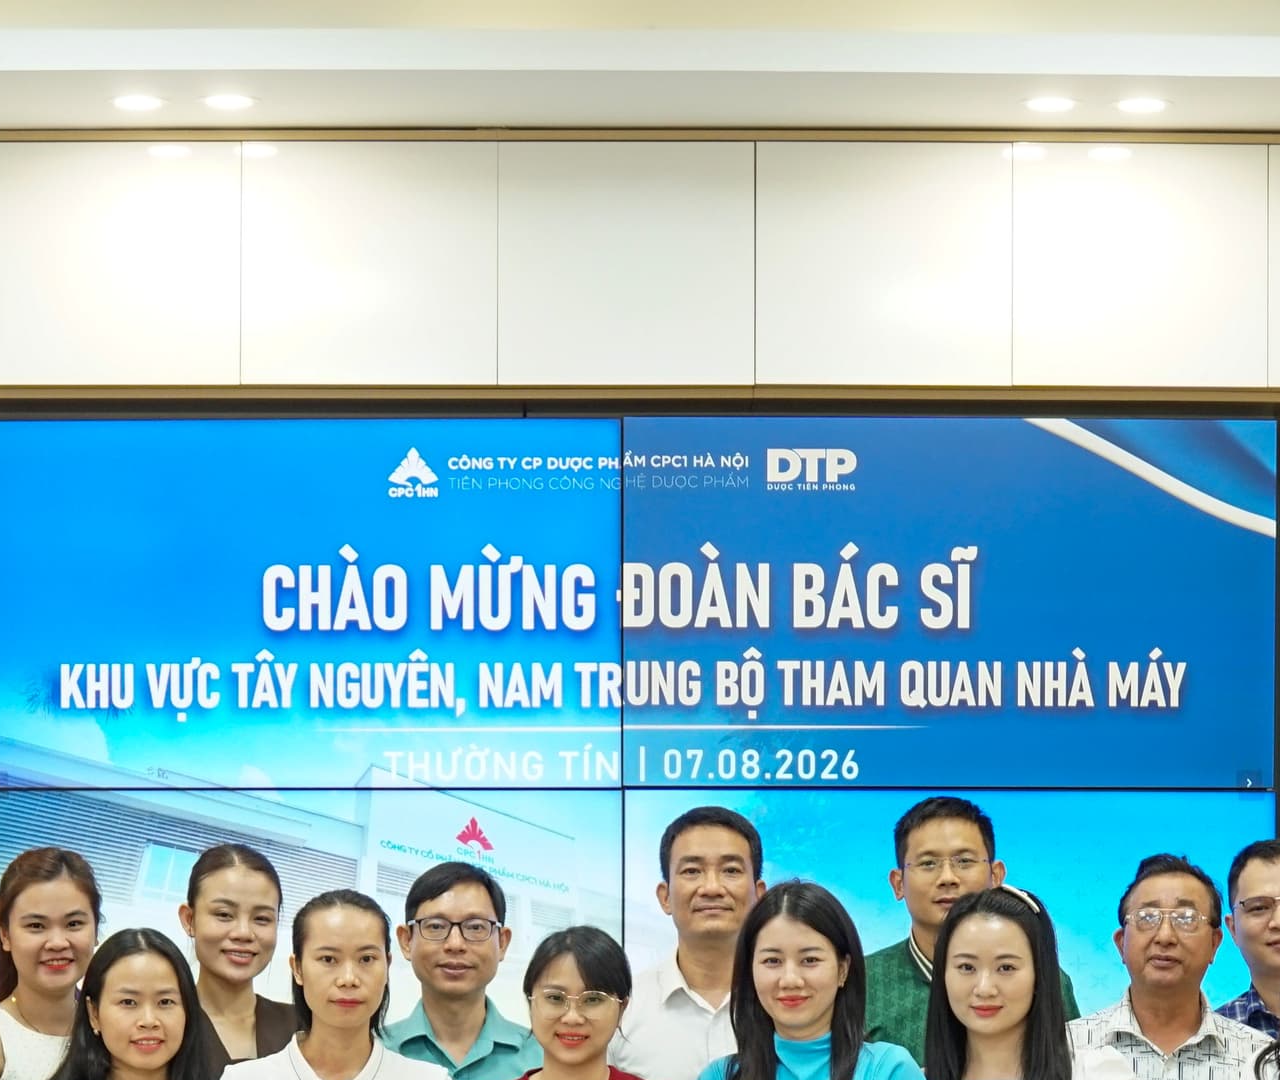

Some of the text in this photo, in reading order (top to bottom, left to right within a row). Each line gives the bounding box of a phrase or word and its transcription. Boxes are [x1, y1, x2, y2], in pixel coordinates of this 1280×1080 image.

[448, 454, 494, 470] CÔNG
[500, 457, 518, 470] TY
[521, 457, 543, 470] CP
[547, 456, 593, 473] DƯỢC
[650, 455, 688, 468] CPC1
[693, 452, 715, 468] HÀ
[721, 452, 749, 471] NỘI
[767, 448, 857, 483] DTP
[448, 475, 482, 490] TIÊN
[488, 477, 544, 490] PHONG
[549, 475, 595, 490] CÔNG
[600, 473, 646, 492] NGHỆ
[651, 475, 698, 491] DƯỢC
[767, 483, 794, 493] DƯỢC
[262, 541, 978, 632] CHÀO MỪNG ĐOÀN BÁC SĨ
[59, 646, 1187, 722] KHU VỰC TÂY NGUYÊN, NAM TRUNG BỘ THAM QUAN NHÀ MÁY
[382, 742, 545, 782] THƯỜNG
[559, 741, 620, 782] TÍN
[662, 748, 860, 780] 07.08.2026
